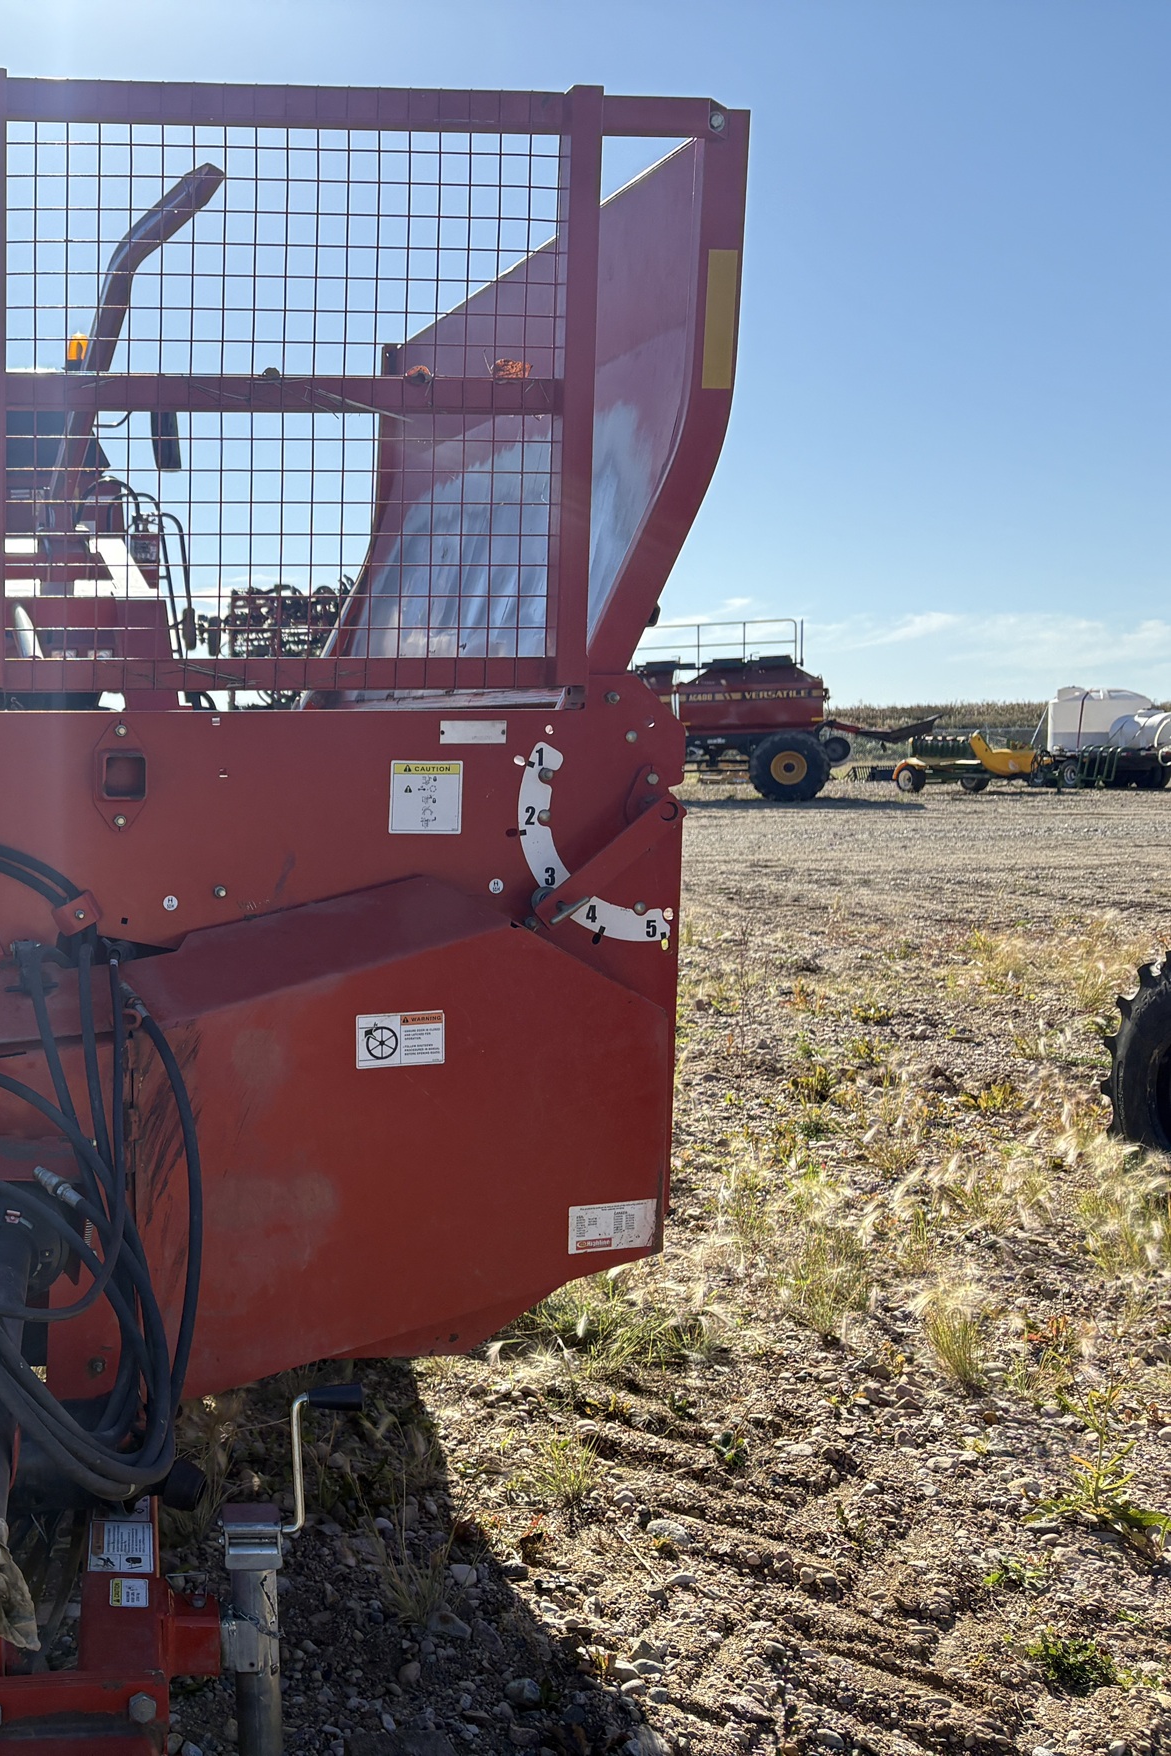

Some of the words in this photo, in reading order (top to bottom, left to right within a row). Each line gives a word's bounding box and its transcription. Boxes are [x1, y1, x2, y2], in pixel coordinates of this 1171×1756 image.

[745, 689, 808, 699] VERSATILE
[535, 747, 544, 767] 1
[525, 806, 535, 826] 2
[544, 867, 556, 886] 3
[586, 905, 598, 923] 4
[645, 919, 657, 938] 5
